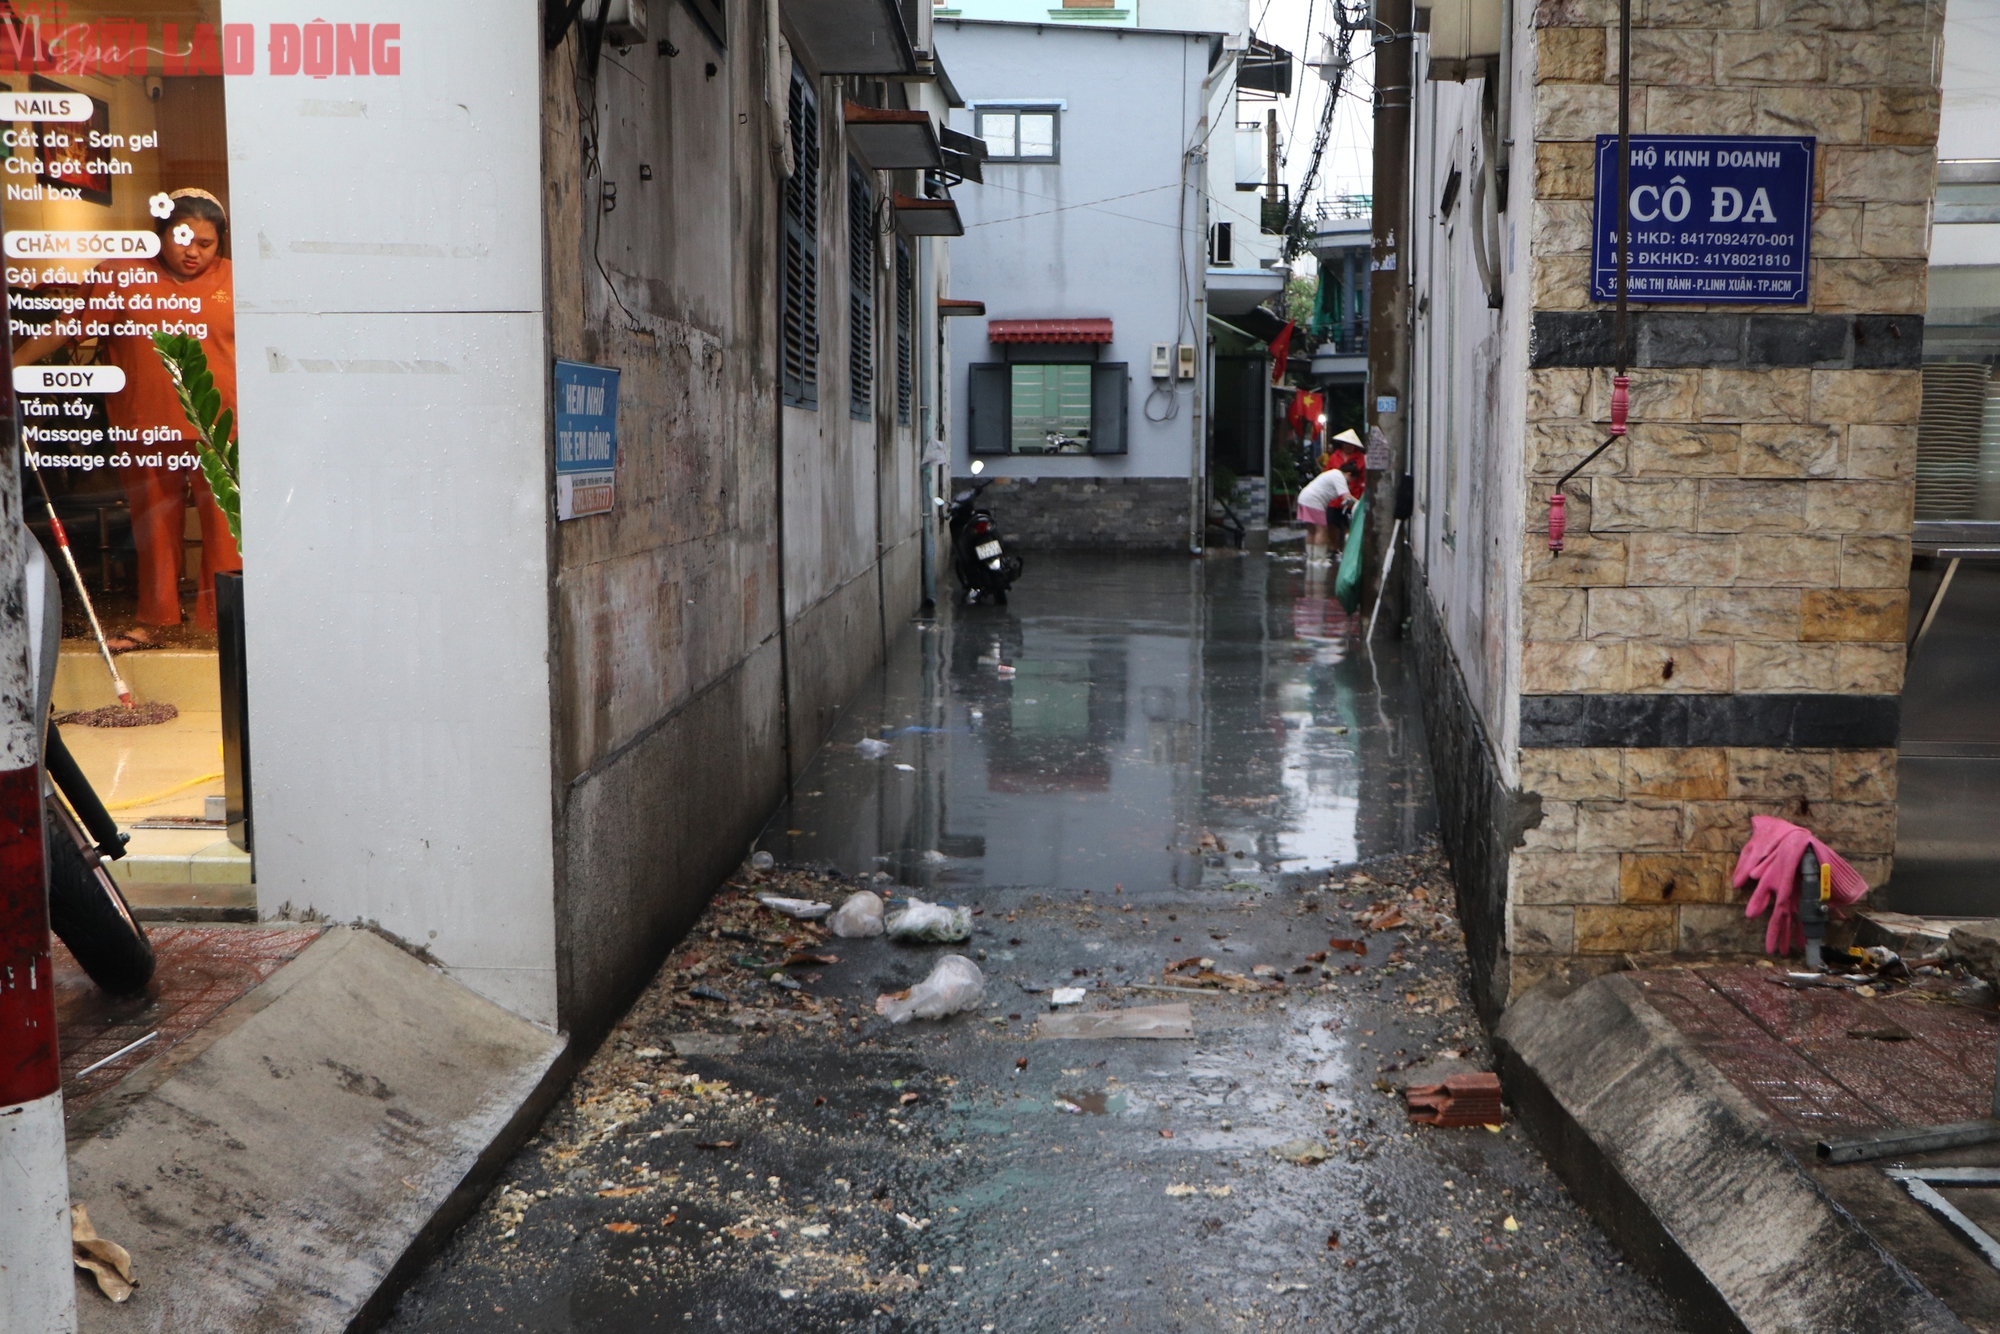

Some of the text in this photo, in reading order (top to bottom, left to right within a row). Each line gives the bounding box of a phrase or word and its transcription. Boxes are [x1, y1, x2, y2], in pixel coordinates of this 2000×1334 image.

[48, 23, 193, 78] Spa
[14, 100, 71, 116] NAILS
[3, 127, 39, 147] Cắt
[43, 130, 69, 147] da
[89, 130, 125, 148] Sơn
[129, 130, 158, 152] gel
[5, 157, 133, 178] Chà gót chân
[1630, 146, 1781, 170] HỘ KINH DOANH
[6, 184, 82, 200] Nail box
[1629, 174, 1777, 223] CÔ ĐA
[16, 234, 147, 253] CHĂM SÓC DA
[1637, 232, 1676, 245] HKD:
[1680, 233, 1794, 246] 8417092470-001
[1638, 252, 1699, 265] ĐKHKD:
[1704, 253, 1791, 267] 41Y8021810
[6, 266, 158, 287] Gội đầu thư giãn
[1626, 277, 1647, 294] ẶNG
[1649, 278, 1664, 293] THỊ
[1666, 276, 1691, 290] RÀNH
[1728, 277, 1753, 291] XUÂN
[8, 293, 85, 314] Massage
[89, 291, 125, 310] mắt
[128, 293, 153, 310] đá
[157, 293, 201, 314] nóng
[9, 318, 208, 339] Phục hồi da căng bóng
[43, 372, 94, 387] BODY
[566, 374, 606, 416] HẺM NHỎ
[20, 397, 94, 419] Tắm tẩy
[22, 426, 182, 446] Massage thư giãn
[559, 420, 611, 462] TRẺ EM ĐÔNG
[24, 451, 105, 470] Massage
[135, 452, 163, 467] vai
[167, 451, 201, 470] gáy
